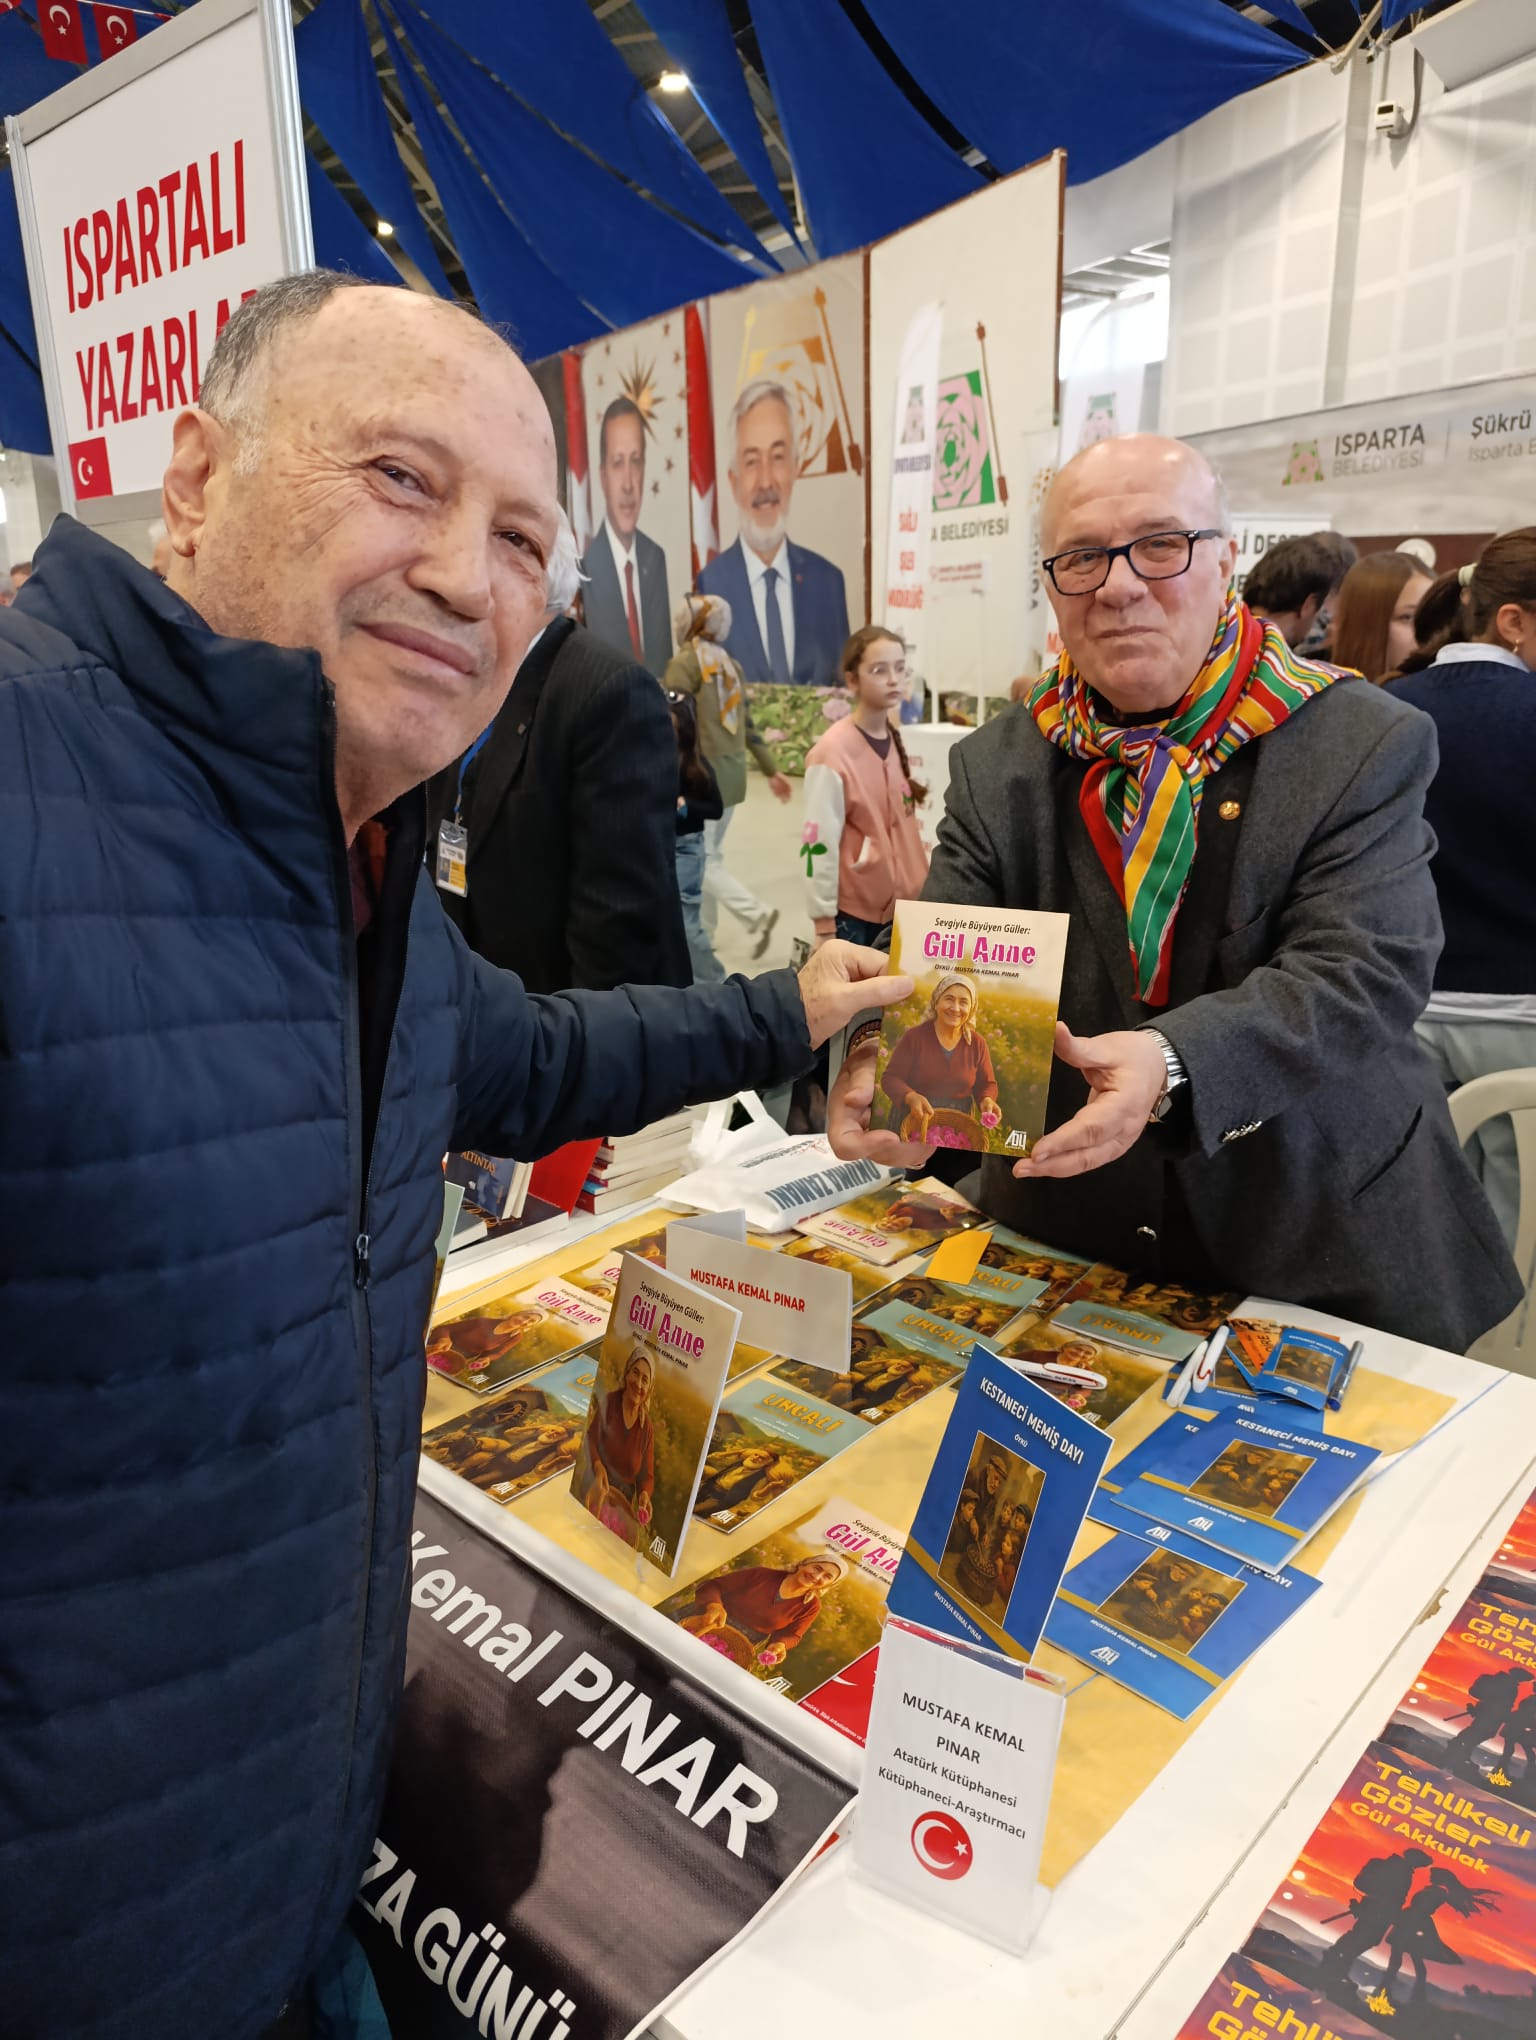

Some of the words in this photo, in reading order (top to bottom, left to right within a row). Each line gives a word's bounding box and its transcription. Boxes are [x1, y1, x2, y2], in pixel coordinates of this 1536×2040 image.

[64, 139, 245, 313] ISPARTALI
[76, 289, 257, 431] YAZARL
[1335, 423, 1425, 456] ISPARTA
[1472, 409, 1532, 438] Şükrü
[924, 931, 965, 959] Gül
[972, 936, 1036, 964] Anne
[935, 917, 967, 930] Sevgiyle
[968, 920, 1002, 933] Büyüyen
[1004, 924, 1031, 935] Güller:
[954, 966, 980, 974] MUSTAFA
[764, 1173, 834, 1210] ZAMANI
[821, 1159, 881, 1192] OKUMA
[538, 1291, 570, 1307] Gül
[562, 1304, 602, 1324] Anne
[640, 1281, 660, 1300] Sevgiyle
[660, 1293, 683, 1313] Büyüyen
[684, 1307, 704, 1324] Güller:
[690, 1268, 735, 1292] MUSTAFA
[737, 1281, 770, 1304] KEMAL
[773, 1292, 805, 1313] PINAR
[630, 1295, 656, 1331] Gül
[658, 1312, 704, 1357] Anne
[980, 1377, 1029, 1422] KESTANECİ
[1027, 1412, 1060, 1449] MEMİŞ
[1060, 1438, 1084, 1465] DAYI
[1235, 1417, 1292, 1440] KESTANECİ
[1292, 1434, 1331, 1451] MEMİŞ
[1330, 1446, 1357, 1459] DAYI
[826, 1524, 871, 1551] Gül
[852, 1520, 880, 1537] Sevgiyle
[934, 1590, 954, 1613] MUSTAFA
[953, 1609, 967, 1628] KEMAL
[967, 1624, 982, 1641] PINAR
[1460, 1632, 1497, 1651] Gül
[902, 1692, 970, 1730] MUSTAFA
[975, 1721, 1025, 1752] KEMAL
[537, 1651, 779, 1858] PINAR
[936, 1735, 981, 1764] PINAR
[893, 1748, 938, 1774] Atatürk
[941, 1766, 1017, 1807] Kütüphanesi
[878, 1766, 1026, 1839] Kütüphaneci-Araştırmacı
[1361, 1781, 1492, 1848] Gözler
[1376, 1761, 1532, 1848] Tehlikeli
[1351, 1802, 1392, 1827] Gül
[1393, 1822, 1489, 1874] Akkulak
[414, 1907, 577, 2040] GÜNÜ
